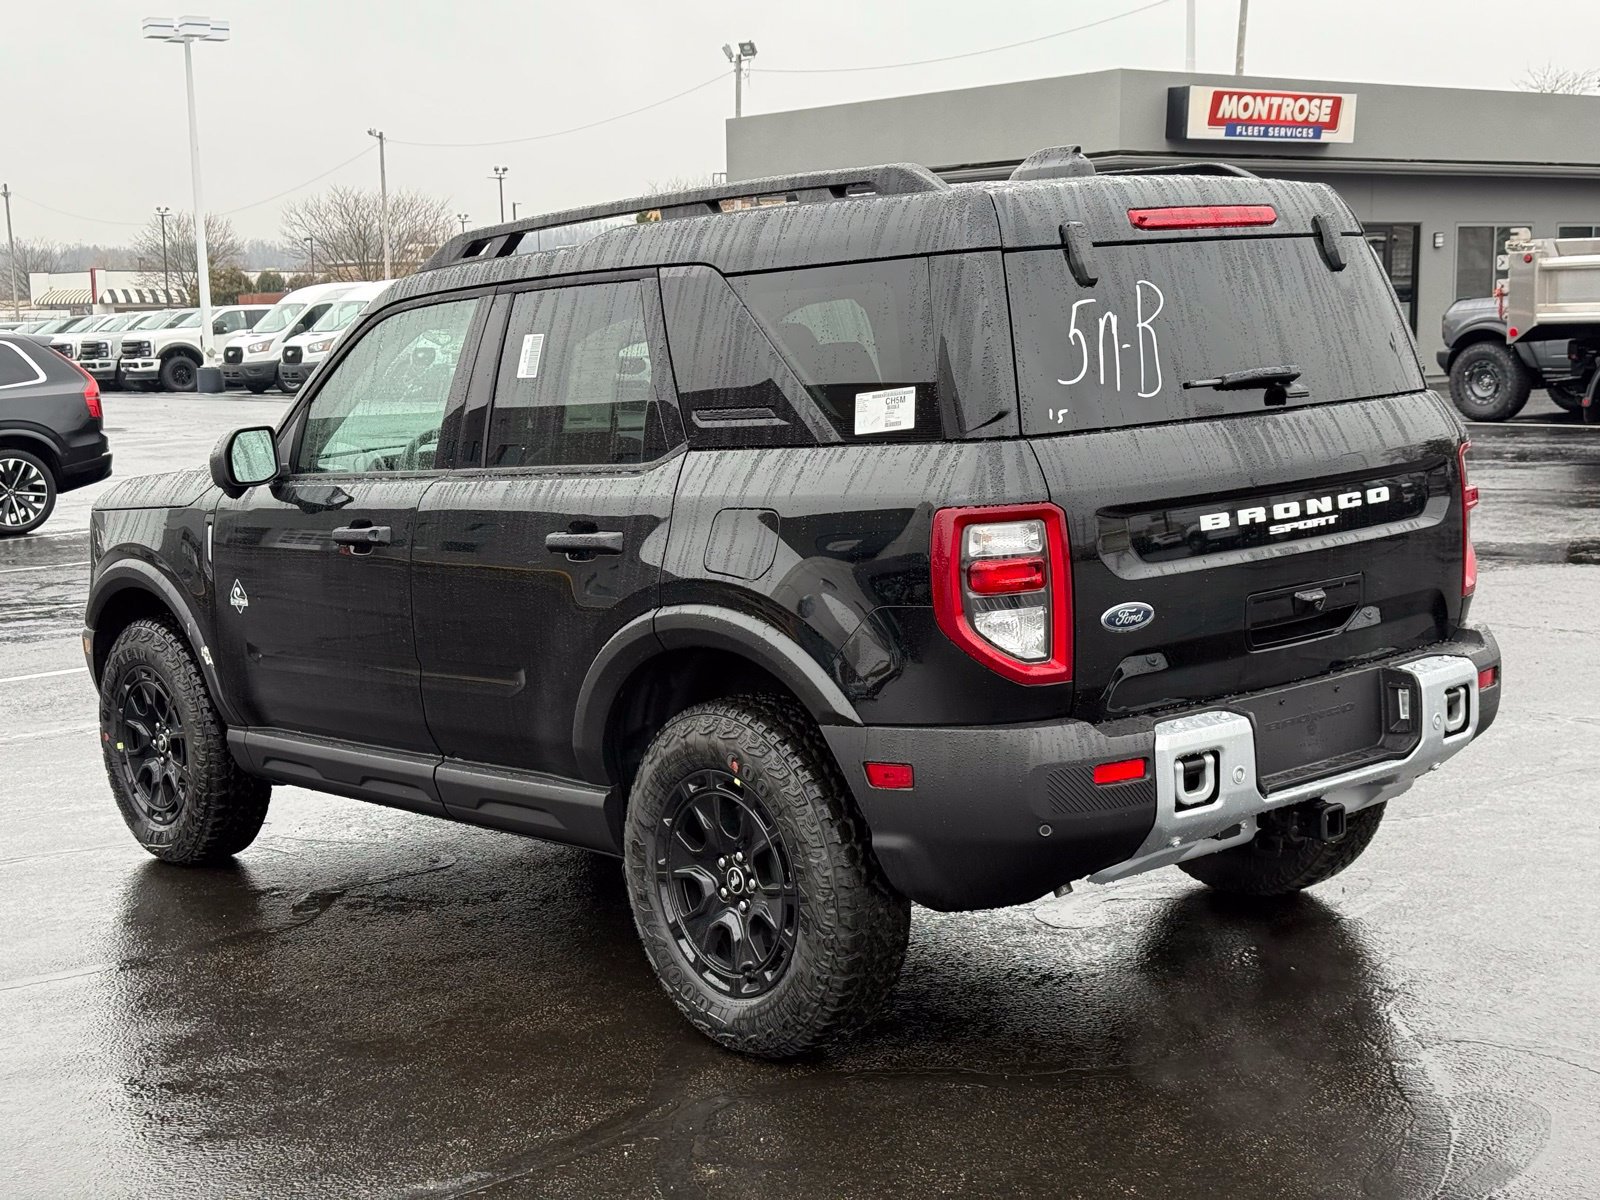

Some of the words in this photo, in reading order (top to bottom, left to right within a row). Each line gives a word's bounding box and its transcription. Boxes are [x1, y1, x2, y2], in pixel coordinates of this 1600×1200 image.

[1216, 94, 1334, 123] MONTROSE
[1236, 125, 1264, 136] FLEET
[1268, 126, 1314, 138] SERVICES
[885, 395, 906, 406] CH5M
[1199, 486, 1390, 531] BRONCO
[1268, 514, 1339, 535] SPORT
[1115, 607, 1144, 626] Ford
